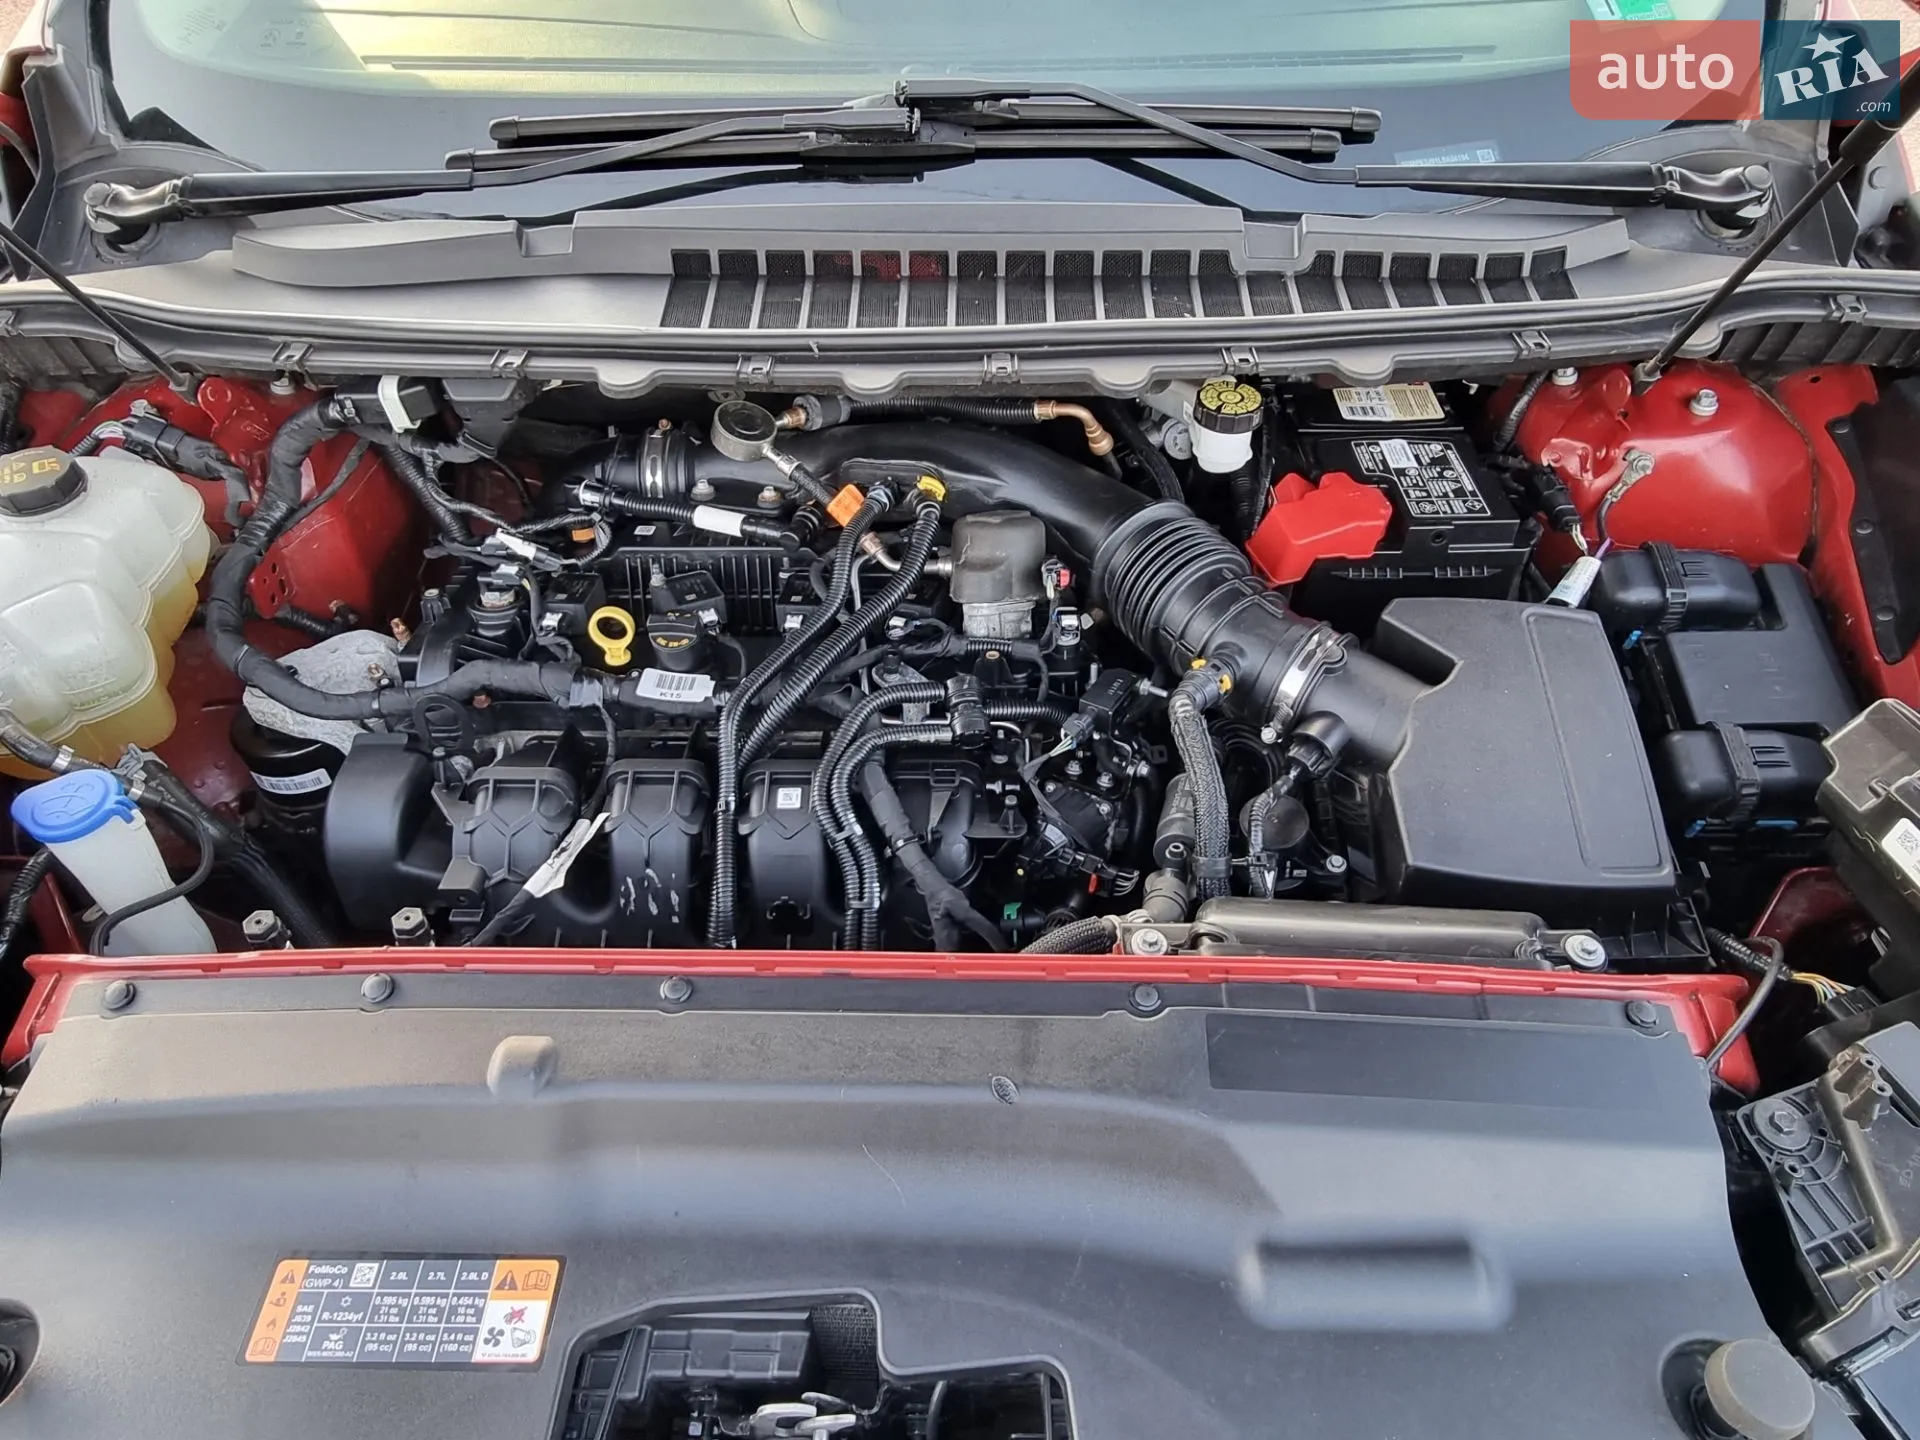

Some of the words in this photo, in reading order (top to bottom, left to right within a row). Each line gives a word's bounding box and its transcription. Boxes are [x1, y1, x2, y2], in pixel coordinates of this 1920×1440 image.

[308, 1264, 348, 1274] FoMoCo
[390, 1271, 409, 1281] 2.0L
[427, 1271, 447, 1281] 2.7L
[480, 1271, 489, 1281] D
[302, 1279, 332, 1289] (GWP
[332, 1279, 344, 1289] 4)
[399, 1296, 409, 1307] kg
[437, 1297, 447, 1307] kg
[451, 1296, 474, 1305] 0.454
[475, 1297, 485, 1307] kg
[296, 1304, 315, 1313] SAE
[379, 1306, 388, 1314] 21
[321, 1311, 364, 1323] R-1234yf
[365, 1332, 378, 1341] 3.2
[404, 1332, 418, 1341] 3.2
[442, 1332, 456, 1341] 5.4
[322, 1340, 344, 1350] PAG
[364, 1343, 378, 1353] (95
[379, 1343, 393, 1353] cc)
[403, 1343, 417, 1353] (95
[418, 1343, 433, 1353] cc)
[440, 1343, 459, 1353] (160
[459, 1343, 473, 1353] cc)
